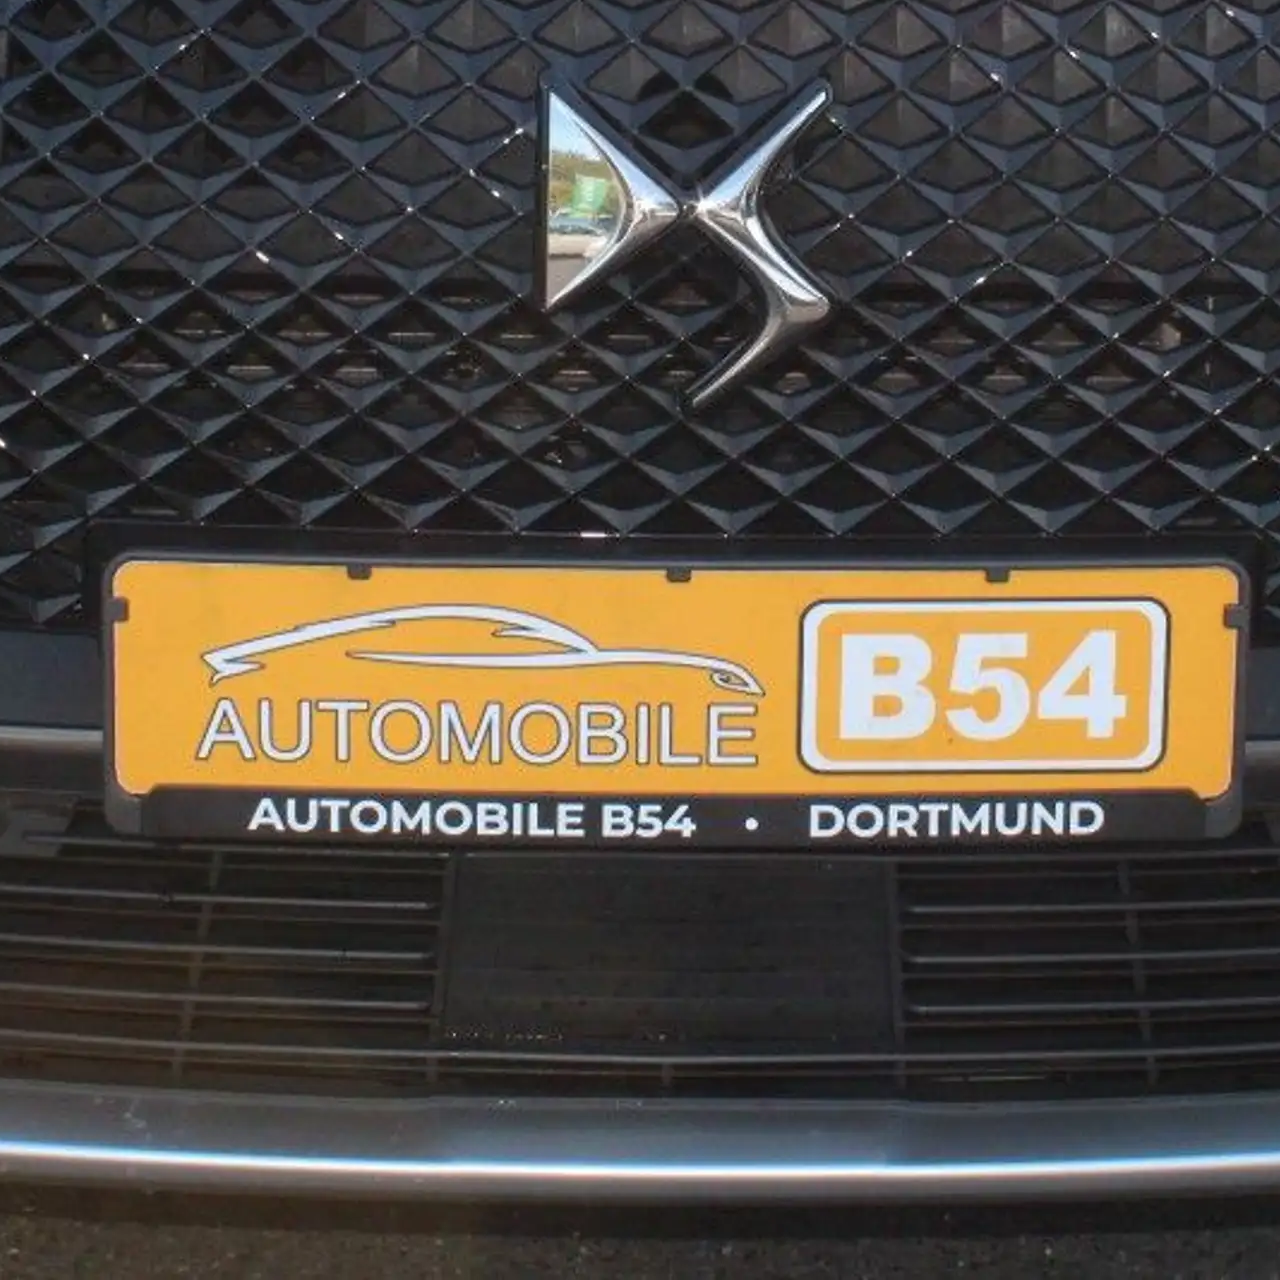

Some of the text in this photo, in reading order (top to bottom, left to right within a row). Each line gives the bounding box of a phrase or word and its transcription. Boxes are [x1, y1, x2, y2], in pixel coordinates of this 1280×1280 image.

[838, 629, 1128, 742] B54
[195, 697, 759, 767] AUTOMOBILE
[248, 797, 1105, 839] AUTOMOBILE B54 DORTMUND
